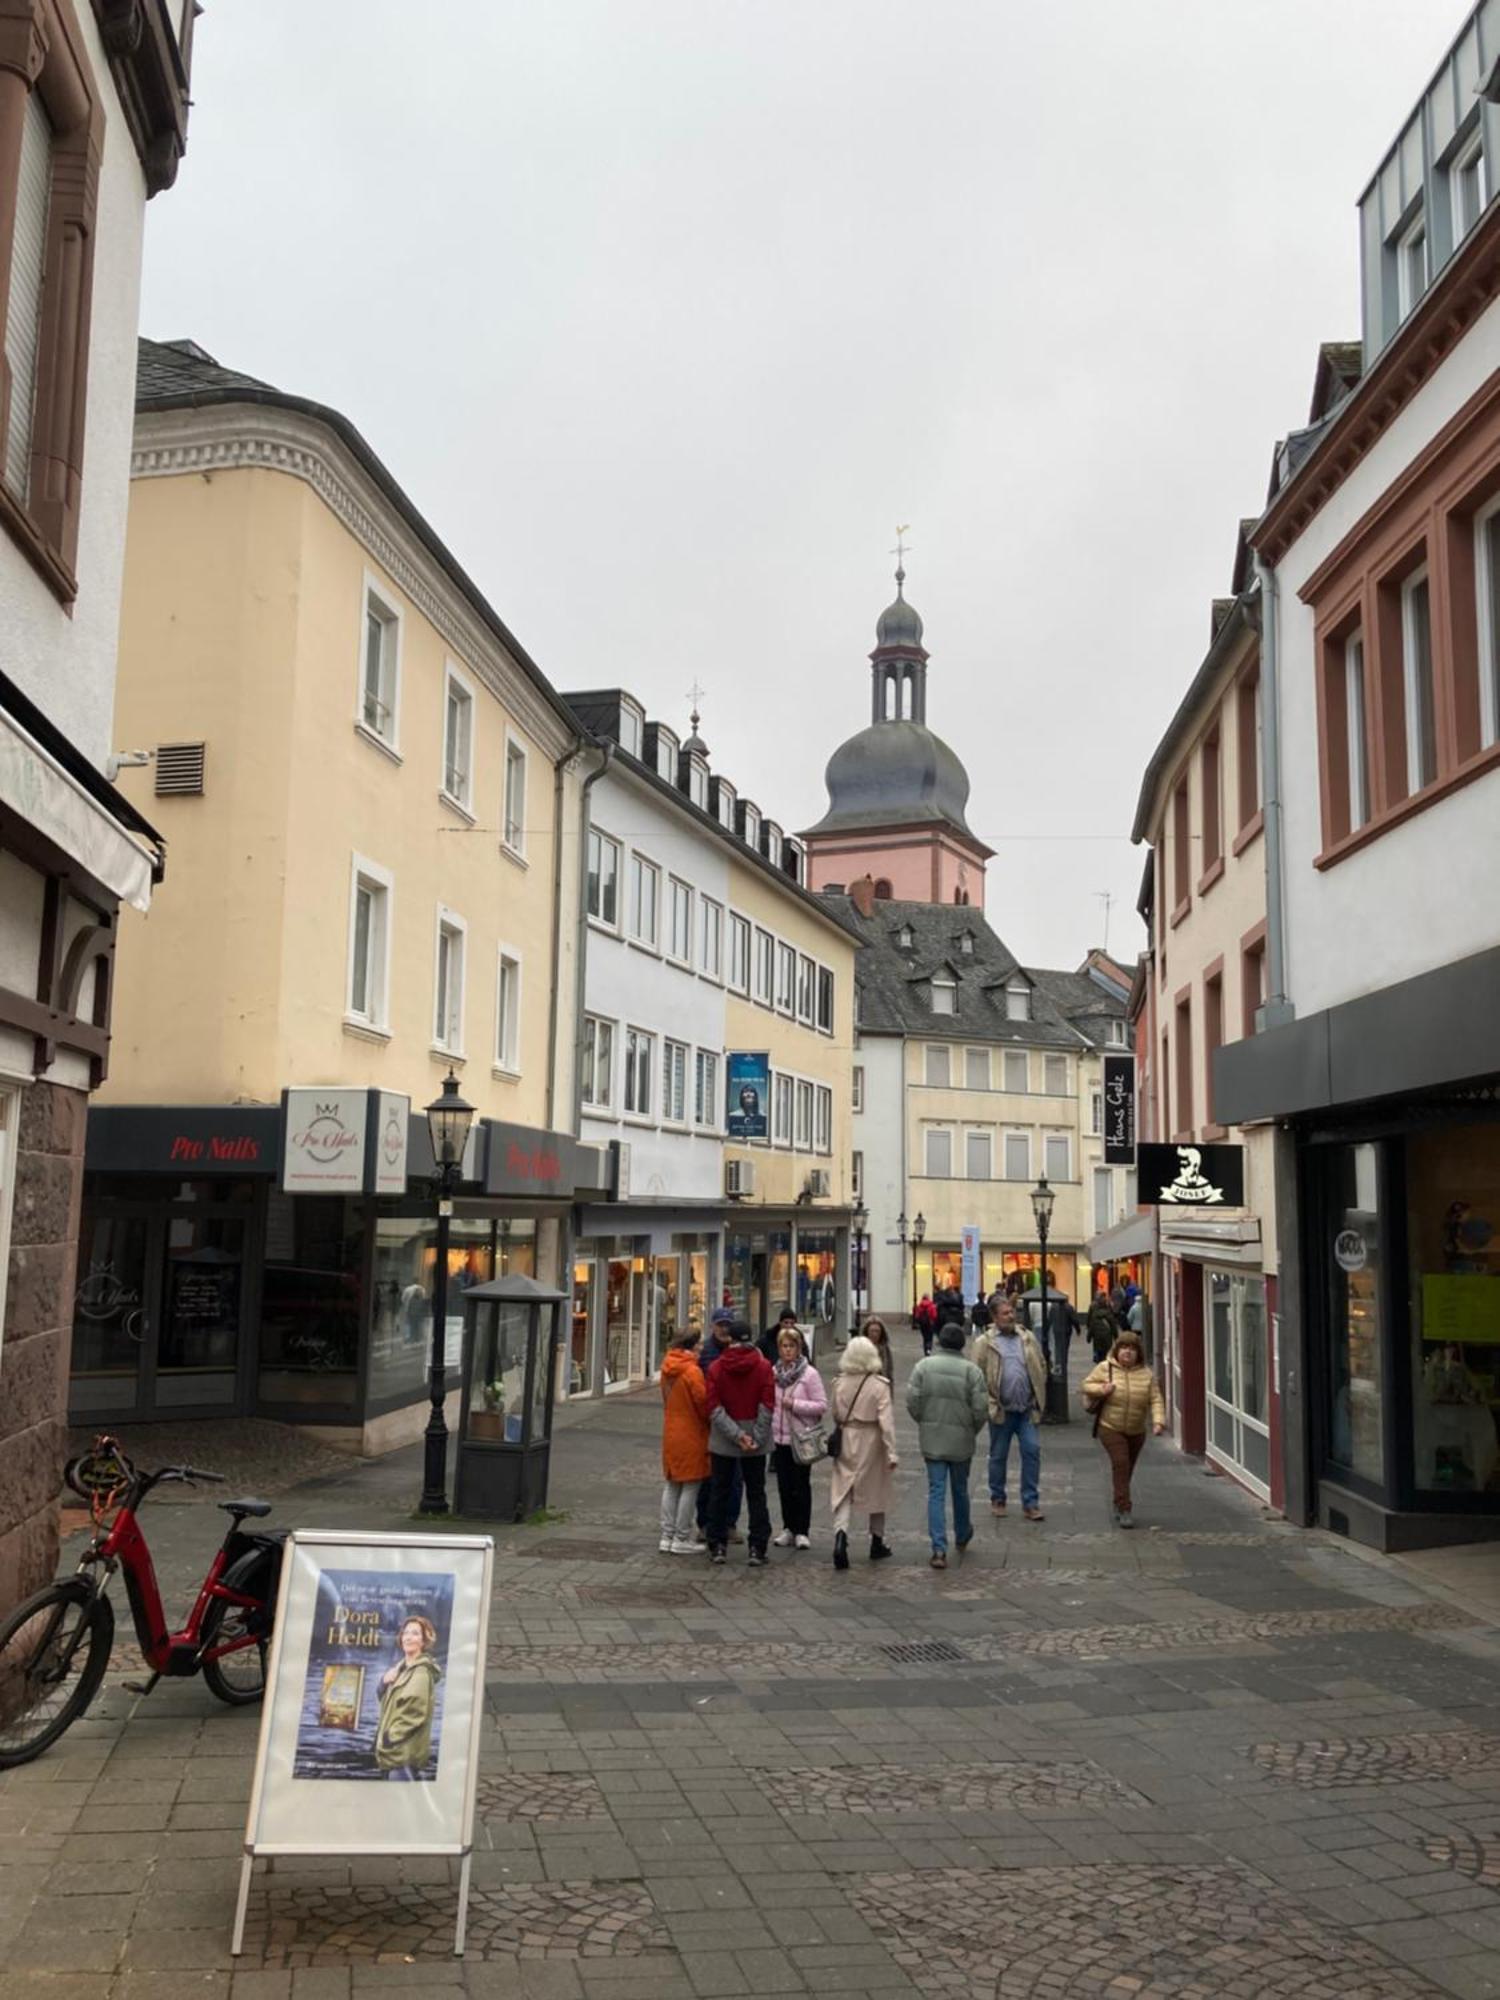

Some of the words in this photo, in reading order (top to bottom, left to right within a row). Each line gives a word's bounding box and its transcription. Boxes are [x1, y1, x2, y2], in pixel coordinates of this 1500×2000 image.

[1106, 1108, 1125, 1148] Hans
[169, 1135, 205, 1161] Pro
[210, 1135, 261, 1161] Nails
[333, 1604, 380, 1625] Dora
[327, 1626, 380, 1647] Heldt
